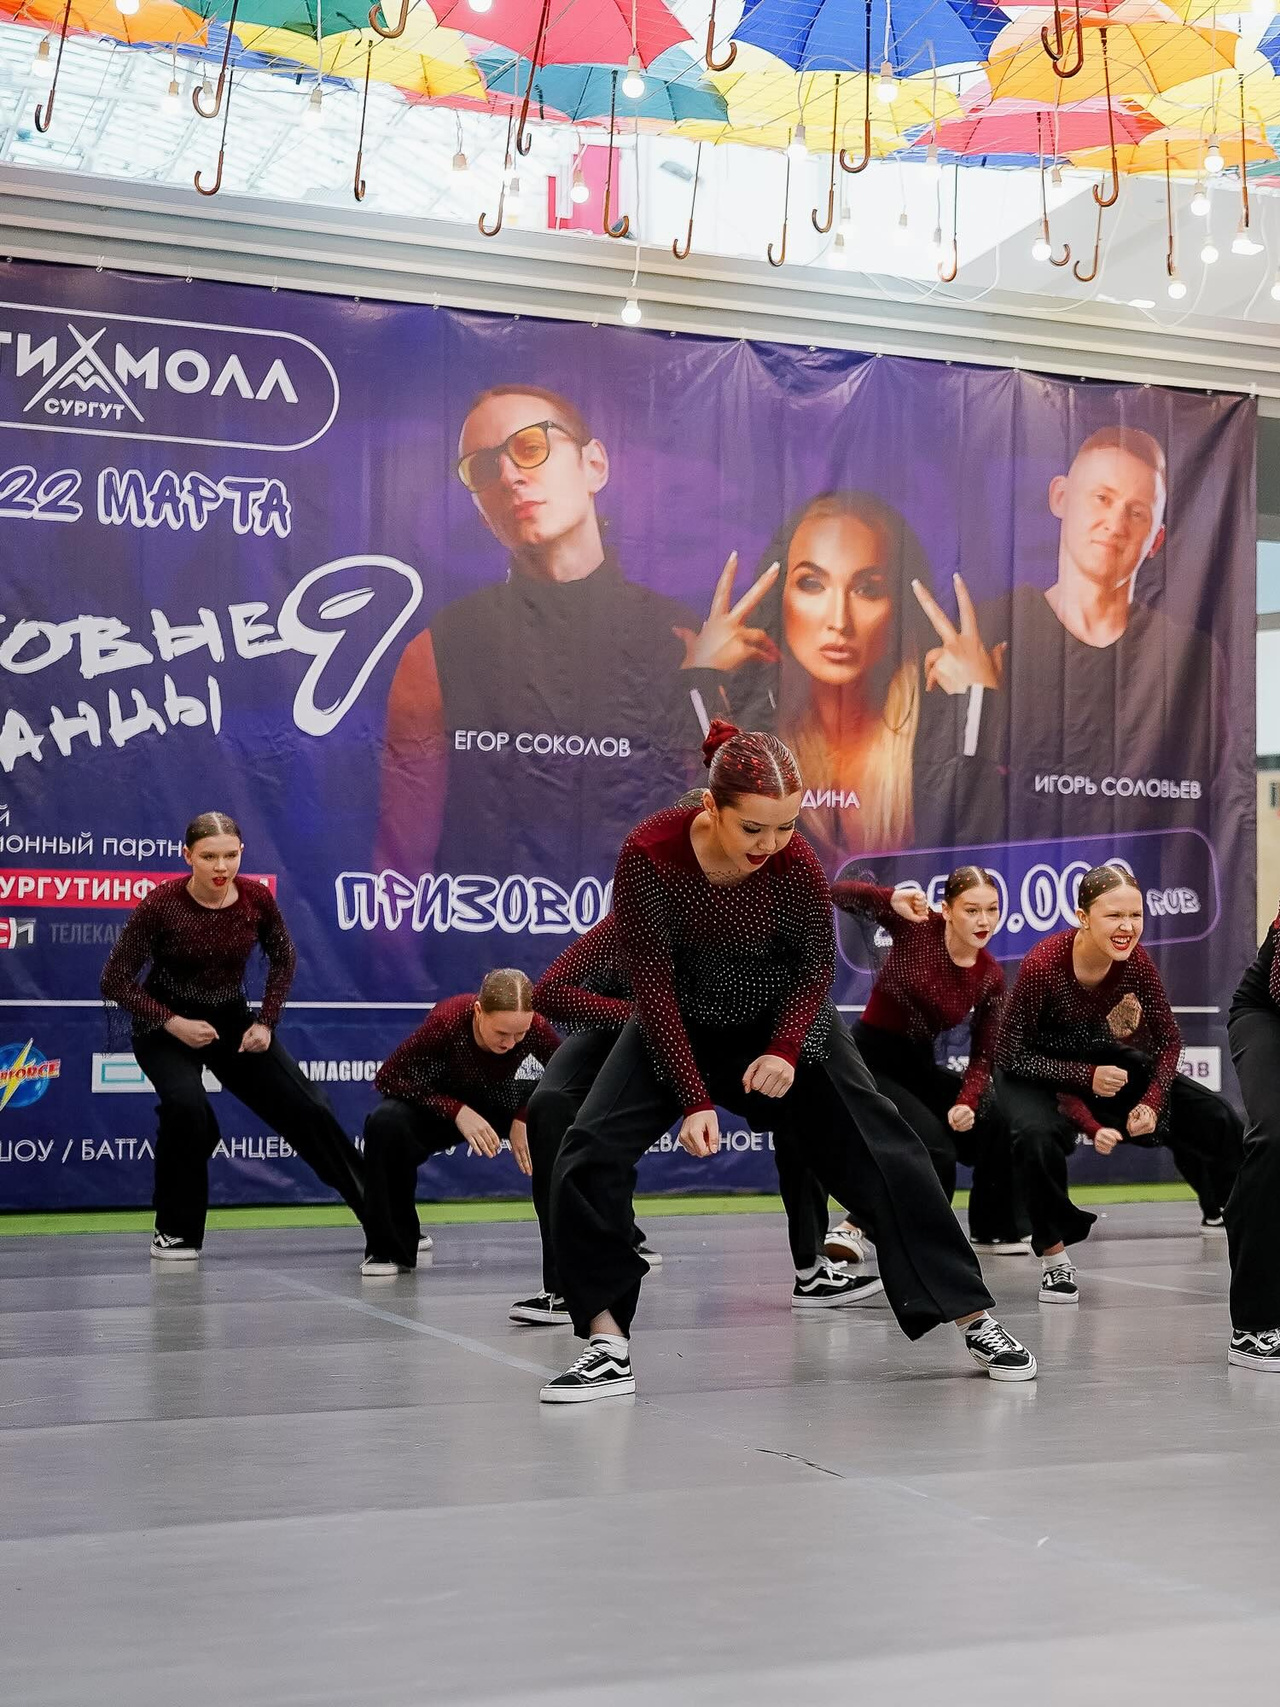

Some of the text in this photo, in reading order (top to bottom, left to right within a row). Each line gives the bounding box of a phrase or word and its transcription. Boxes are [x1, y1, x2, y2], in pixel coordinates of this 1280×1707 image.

[44, 397, 125, 420] СУРГУТ
[98, 467, 292, 538] МАРТА
[0, 601, 285, 679] ОВЫЕ
[455, 730, 632, 758] ЕГОР СОКОЛОВ
[1034, 774, 1203, 800] ИГОРЬ СОЛОВЬЕВ
[0, 831, 94, 855] онный
[0, 875, 176, 901] УРГУТИНФ
[334, 868, 615, 936] ПРИЗОВО
[1145, 888, 1202, 918] RUB
